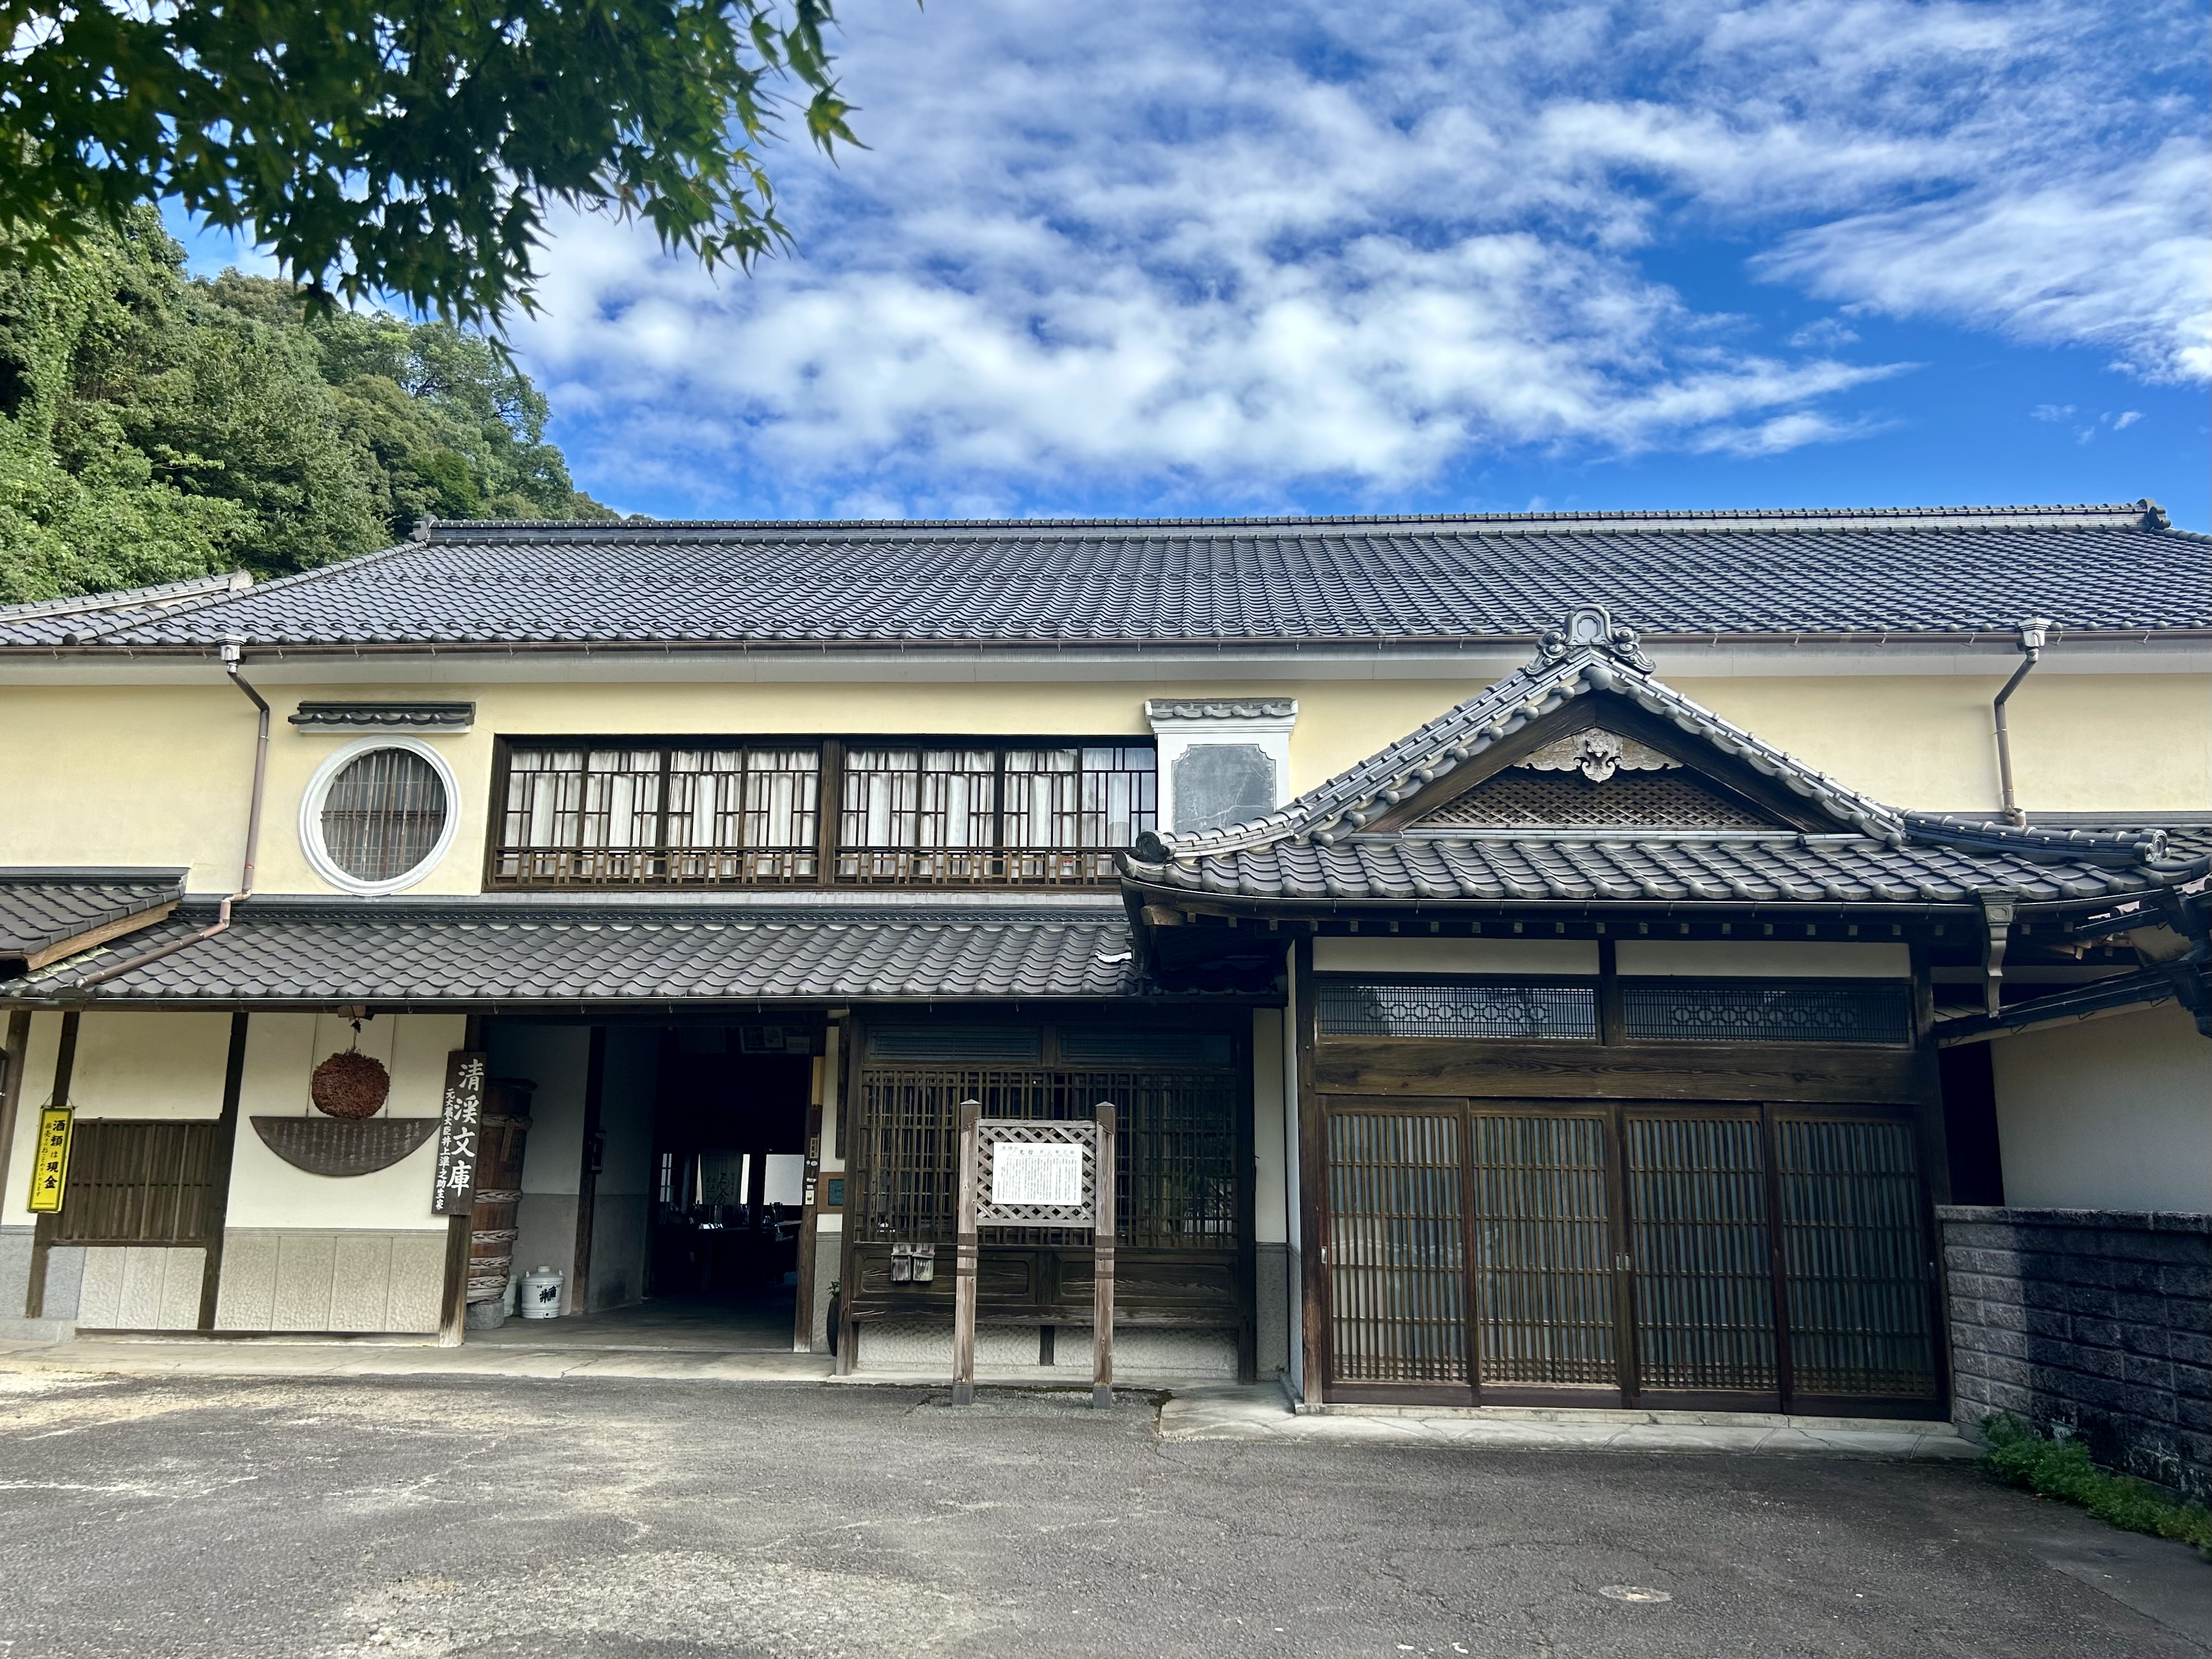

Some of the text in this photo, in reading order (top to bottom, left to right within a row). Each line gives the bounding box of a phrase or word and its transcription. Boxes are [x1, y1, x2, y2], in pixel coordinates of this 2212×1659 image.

[44, 1120, 66, 1189] 酒類は現金
